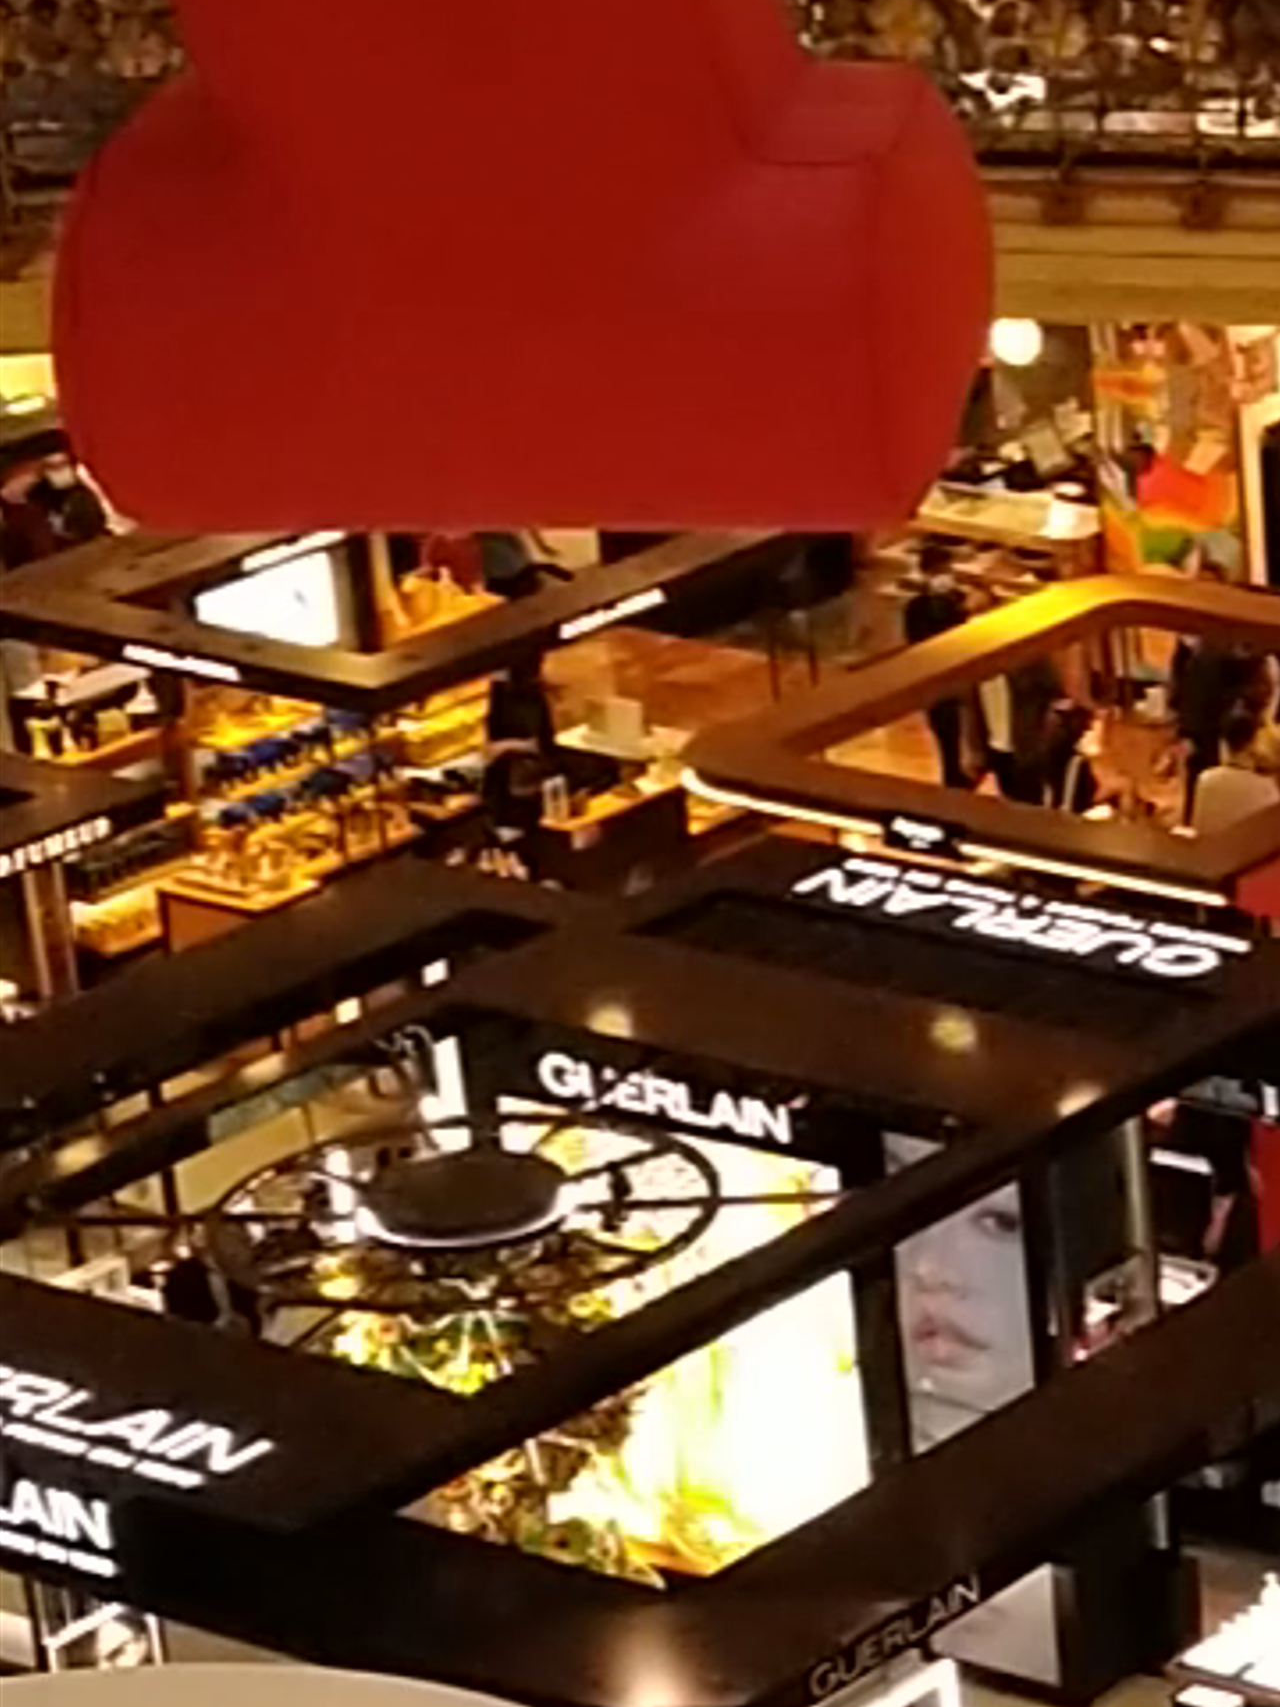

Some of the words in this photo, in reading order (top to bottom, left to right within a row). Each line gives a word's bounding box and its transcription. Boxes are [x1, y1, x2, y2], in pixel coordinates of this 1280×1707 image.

[793, 867, 1221, 977] GUERLAIN
[0, 1365, 274, 1473] RLAIN
[809, 1573, 981, 1697] GUERLAIN
